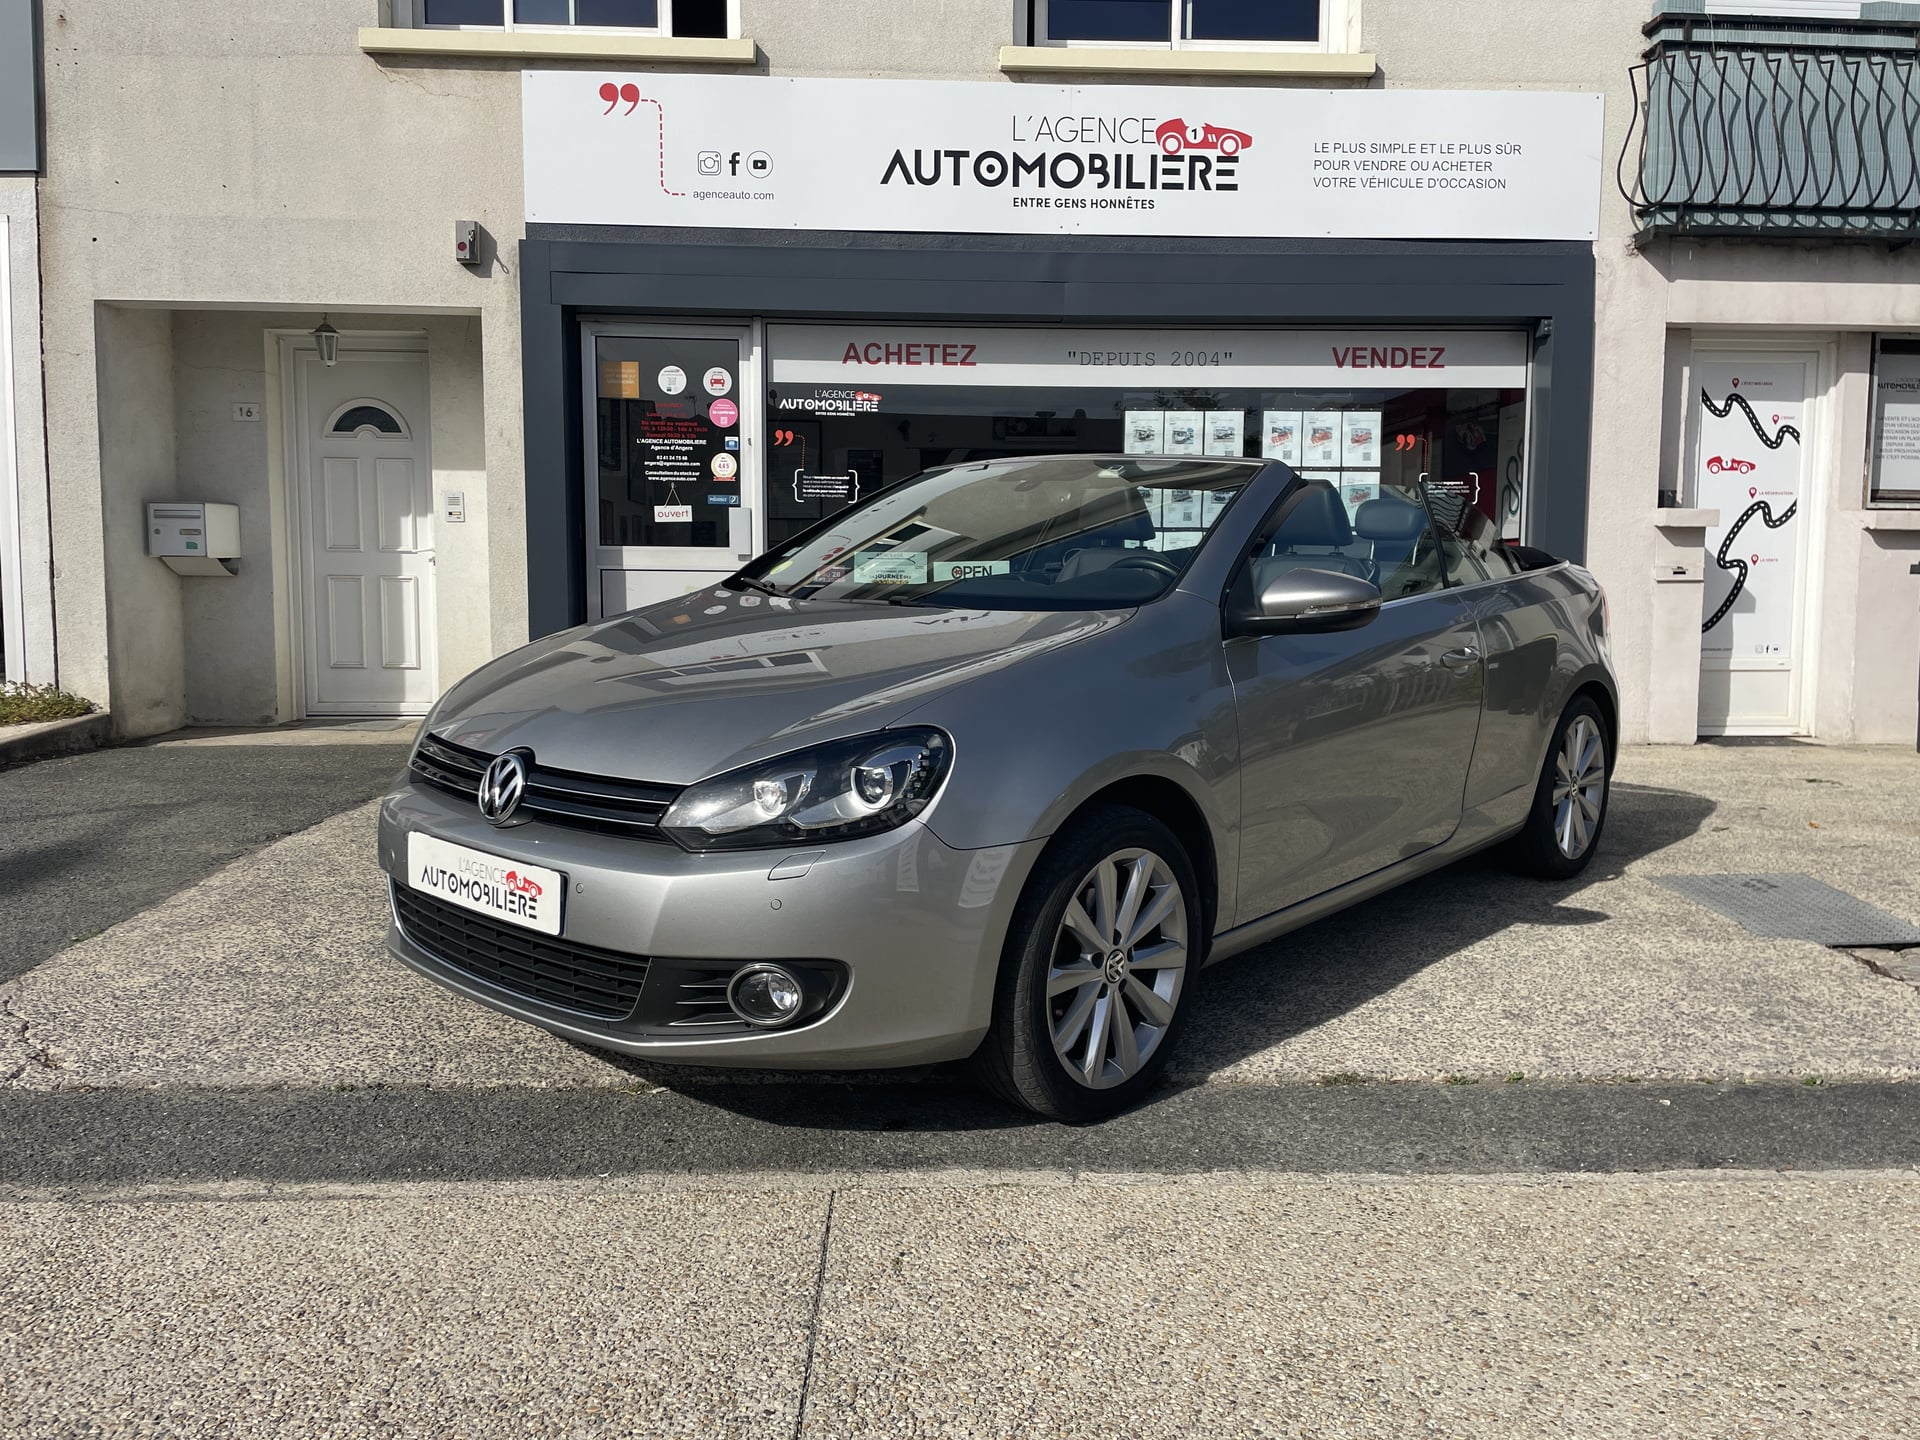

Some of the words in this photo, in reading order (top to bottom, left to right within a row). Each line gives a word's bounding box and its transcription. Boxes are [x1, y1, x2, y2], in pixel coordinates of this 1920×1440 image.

[1012, 115, 1157, 144] L'AGENCE
[1314, 142, 1330, 154] LE
[1333, 142, 1367, 154] PLUS
[1369, 142, 1417, 154] SIMPLE
[1420, 143, 1437, 154] ET
[1439, 143, 1455, 155] LE
[1458, 143, 1492, 155] PLUS
[1495, 142, 1522, 156] SÛR
[1313, 159, 1350, 171] POUR
[1353, 160, 1407, 172] VENDRE
[1410, 160, 1430, 172] OU
[1431, 160, 1493, 172] ACHETER
[1313, 176, 1357, 188] VOTRE
[1360, 175, 1424, 189] VÉHICULE
[1427, 177, 1507, 190] D'OCCASION
[692, 189, 775, 202] agenceauto.com
[1013, 197, 1051, 208] ENTRE
[1054, 198, 1087, 209] GENS
[1090, 195, 1155, 210] HONNÊTES
[841, 342, 977, 367] ACHETEZ
[1331, 346, 1446, 369] VENDEZ
[815, 389, 855, 399] L'AGENCE
[239, 406, 253, 418] 16
[657, 509, 689, 518] ouvert
[458, 855, 507, 886] L'AGENCE
